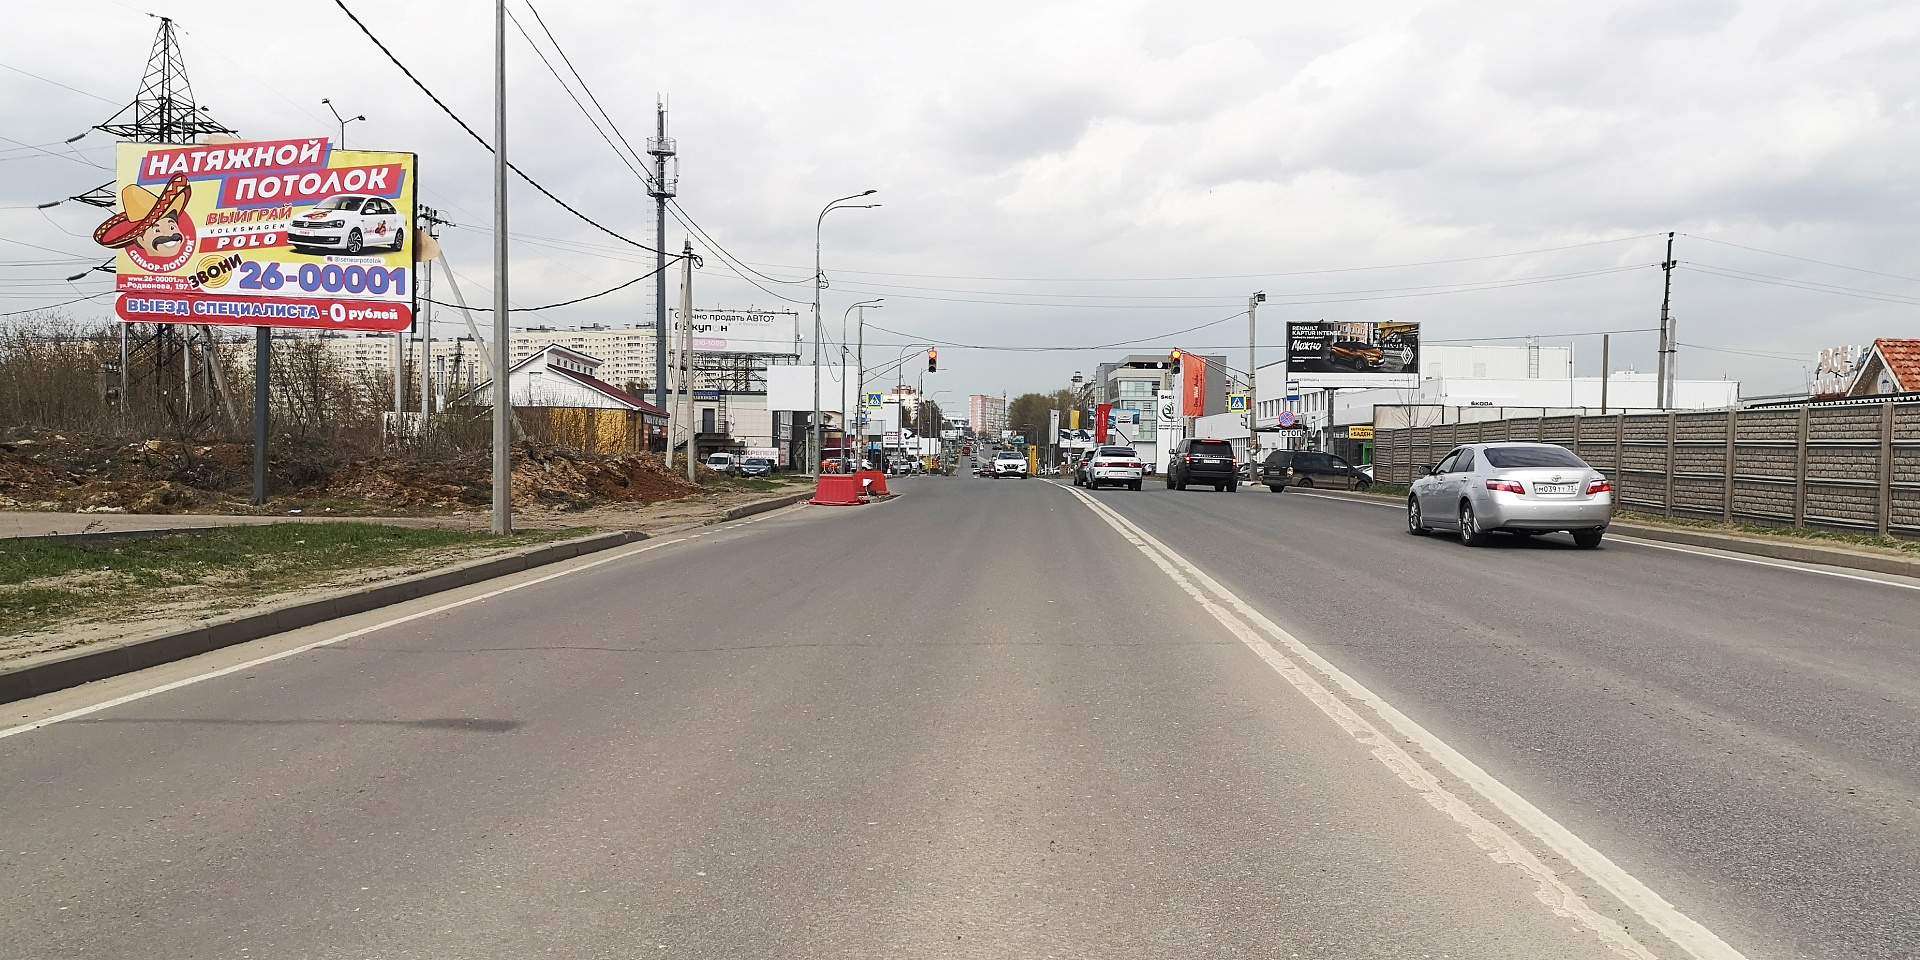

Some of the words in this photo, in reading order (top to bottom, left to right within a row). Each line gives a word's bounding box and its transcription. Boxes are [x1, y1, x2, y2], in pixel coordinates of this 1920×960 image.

[148, 140, 321, 176] НАТЯЖНОЙ
[235, 168, 389, 200] ПОТОЛОК
[206, 203, 293, 225] ВЫИГРАЙ
[210, 223, 285, 234] VOLKSWAGEN
[216, 233, 277, 249] POLO
[188, 254, 243, 290] ЗВОНИ
[239, 262, 406, 296] 26-00001
[127, 299, 190, 315] ВЫЕЗД
[195, 302, 319, 319] СПЕЦИАЛИСТА
[349, 307, 398, 321] рублей
[710, 314, 744, 322] продать
[747, 314, 775, 323] АВТО?
[1291, 339, 1322, 352] Можно
